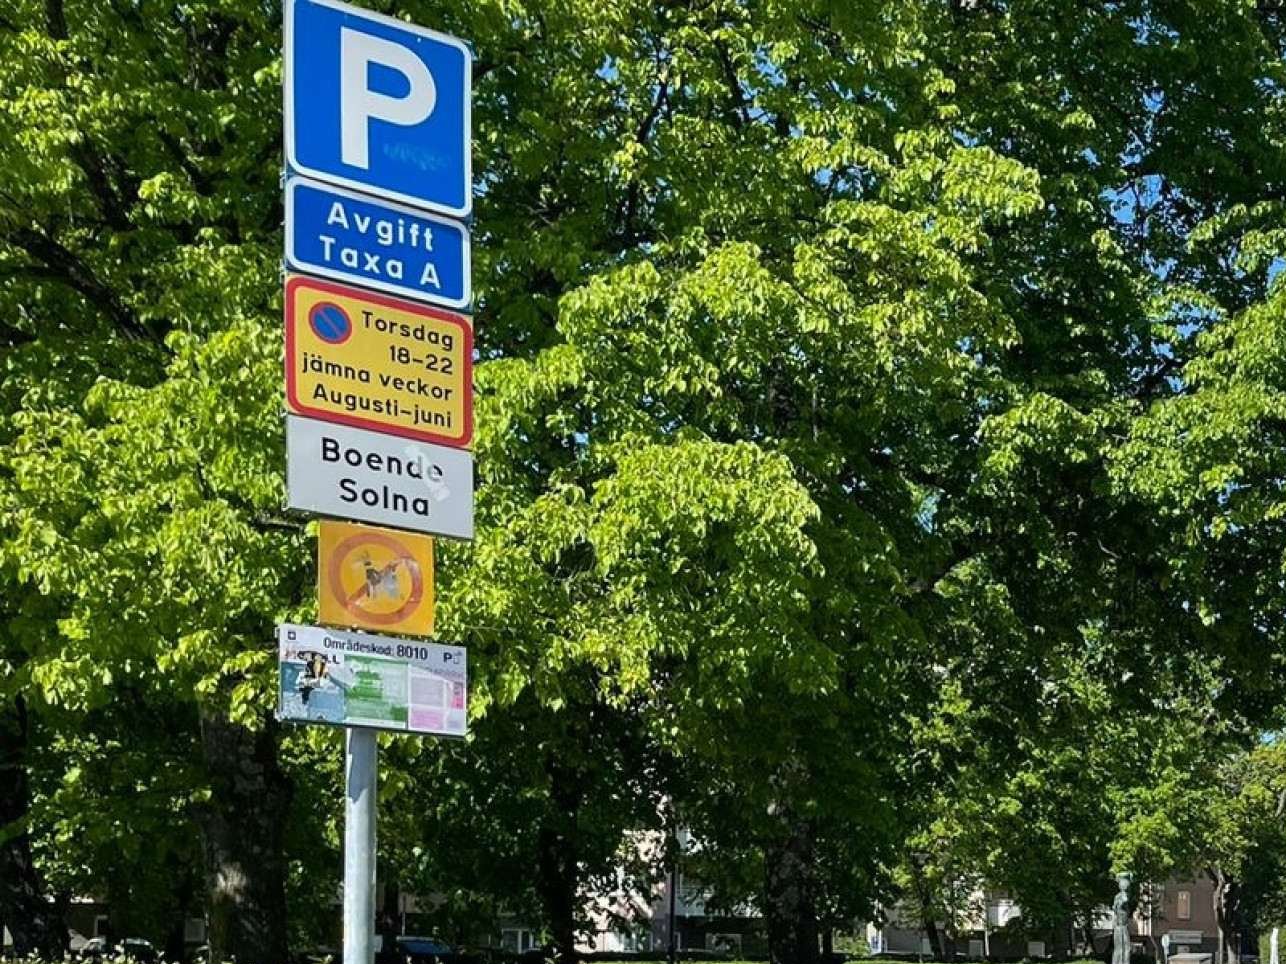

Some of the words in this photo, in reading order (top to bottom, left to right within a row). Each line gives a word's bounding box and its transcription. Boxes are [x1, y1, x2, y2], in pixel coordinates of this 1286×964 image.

[341, 27, 437, 170] P
[327, 201, 435, 252] Avgift
[319, 236, 404, 280] Taxa
[420, 261, 442, 290] A
[362, 311, 454, 351] Torsdag
[302, 352, 371, 385] jämna
[380, 371, 453, 400] veckor
[321, 436, 444, 480] Boende
[339, 477, 430, 517] Solna
[323, 636, 395, 657] Områdeskod:
[396, 643, 429, 661] 8010
